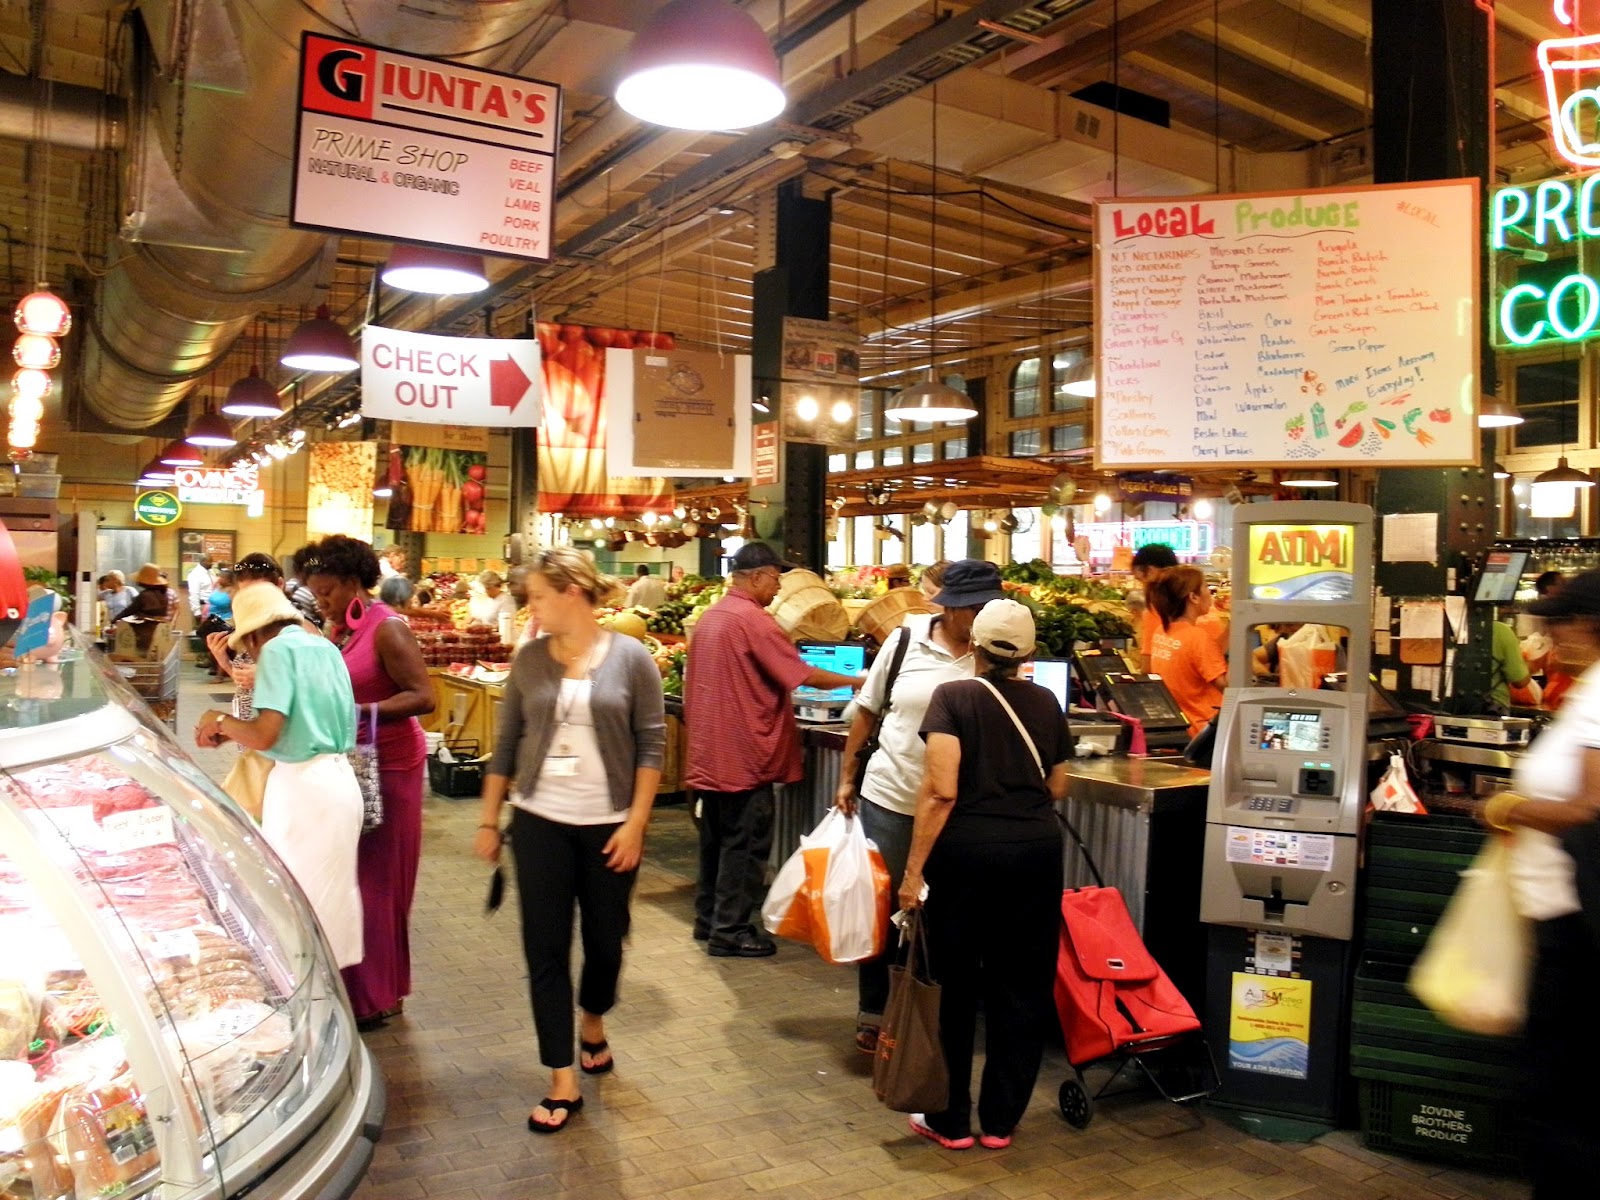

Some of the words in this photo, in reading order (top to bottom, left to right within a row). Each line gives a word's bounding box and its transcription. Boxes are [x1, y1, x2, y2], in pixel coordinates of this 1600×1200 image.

[317, 48, 547, 125] GIUNTA'S
[311, 128, 391, 162] PRIME
[396, 144, 469, 173] SHOP
[508, 158, 544, 174] BEEF
[307, 157, 377, 183] NATURAL
[380, 171, 391, 184] &
[392, 171, 461, 196] ORGANIC
[508, 178, 542, 194] VEAL
[504, 197, 542, 213] LAMB
[503, 216, 540, 232] PORK
[479, 231, 540, 251] POULTRY
[371, 343, 480, 378] CHECK
[394, 380, 459, 409] OUT
[1258, 529, 1346, 567] ATM
[1420, 1104, 1466, 1120] IOVINE
[1411, 1114, 1474, 1133] BROTHERS
[1415, 1126, 1469, 1144] PRODUCE
